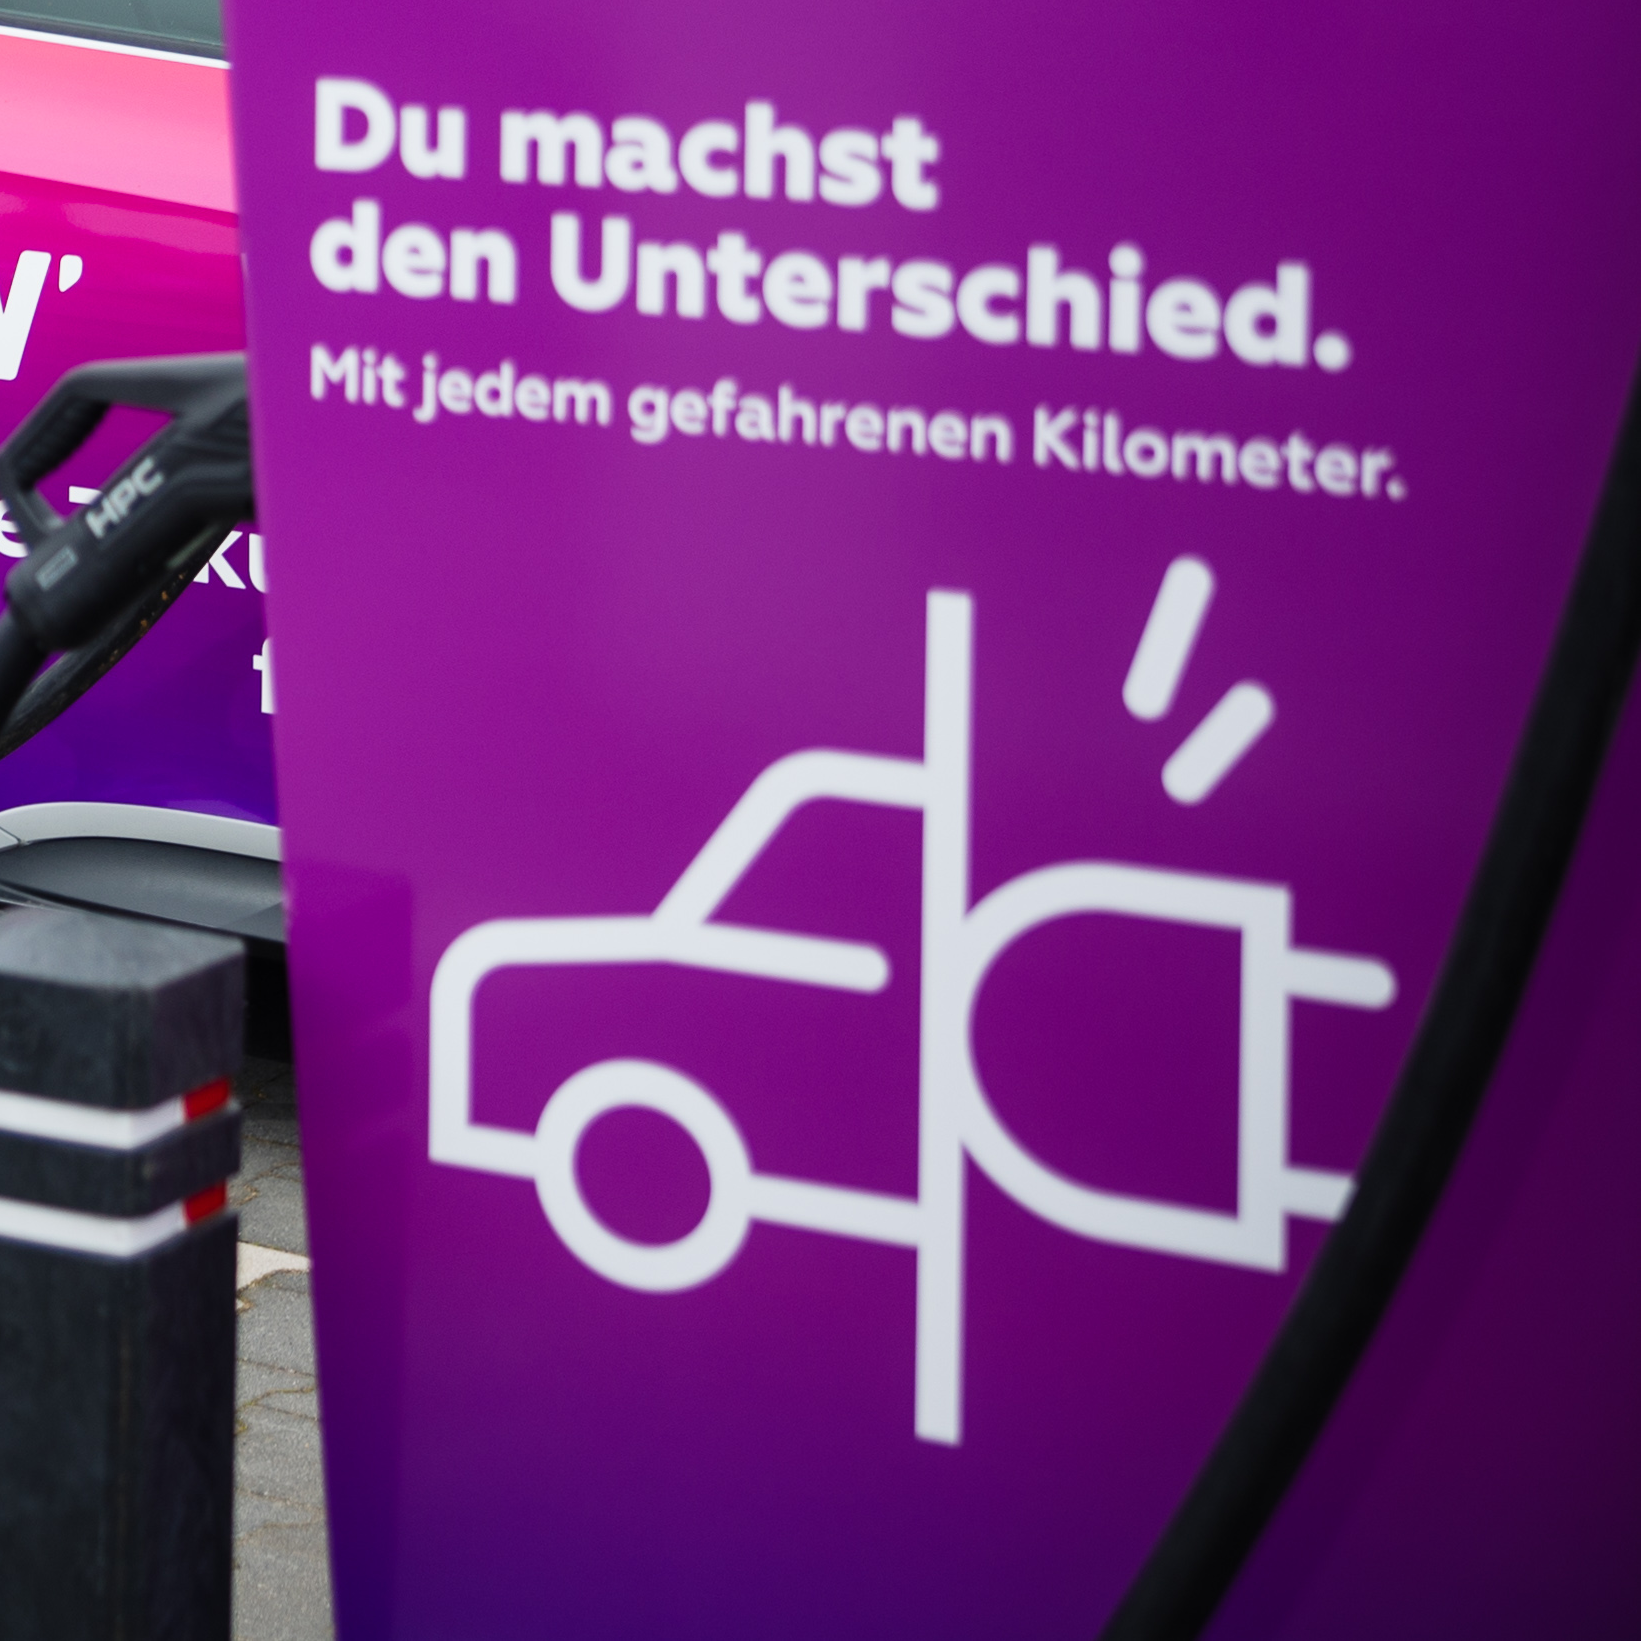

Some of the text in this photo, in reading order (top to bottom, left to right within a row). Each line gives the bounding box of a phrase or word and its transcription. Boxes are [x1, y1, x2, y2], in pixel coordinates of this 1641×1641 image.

[314, 76, 941, 211] Du machst
[309, 198, 1350, 371] den Unterschied.
[309, 343, 1405, 499] Mit jedem gefahrenen Kilometer.
[85, 457, 165, 540] HPC
